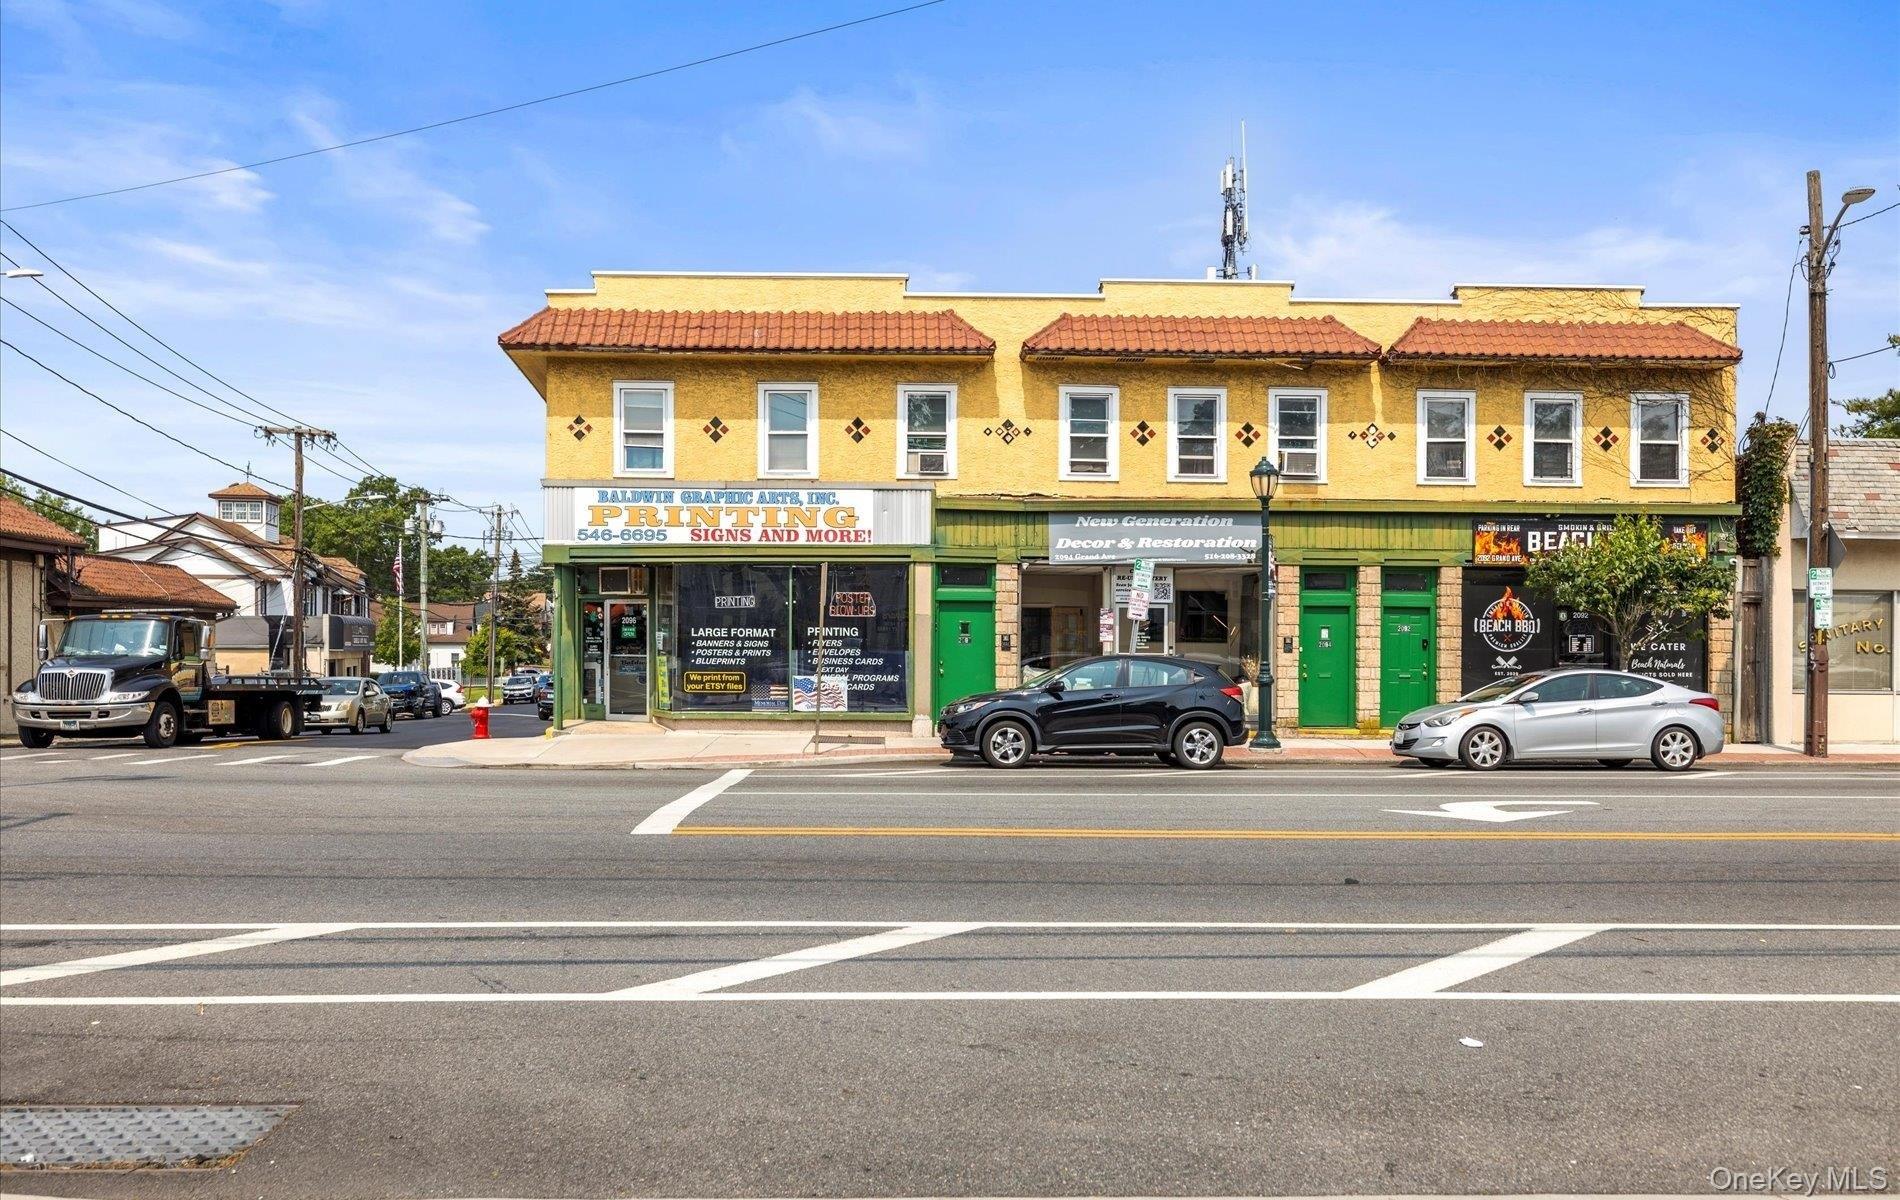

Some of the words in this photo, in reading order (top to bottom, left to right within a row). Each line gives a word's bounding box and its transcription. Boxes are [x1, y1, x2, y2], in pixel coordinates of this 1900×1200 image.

[597, 489, 675, 504] BALDWIN
[680, 490, 754, 505] GRAPHIC
[756, 491, 804, 506] ARTS,
[806, 491, 840, 505] INC.
[587, 505, 860, 528] PRINTING
[1075, 516, 1119, 527] New
[1121, 515, 1234, 527] Generation
[577, 528, 668, 541] 546-6695
[690, 528, 752, 542] SIGNS
[758, 529, 800, 542] AND
[805, 529, 872, 543] MORE!
[1055, 538, 1116, 549] Decor
[1117, 537, 1135, 549] &
[1136, 536, 1258, 548] Restoration
[1477, 554, 1489, 562] 2092
[1491, 554, 1510, 562] GRAND
[1136, 560, 1141, 569] 2
[1810, 569, 1816, 579] 2
[716, 597, 755, 607] PRINTING
[836, 593, 870, 603] POSTER
[830, 605, 875, 615] BLOW-UPS
[1479, 619, 1512, 633] BEACH
[1515, 620, 1536, 633] BBQ
[691, 628, 728, 637] LARGE
[731, 628, 776, 637] FORMAT
[807, 627, 859, 637] PRINTING
[1798, 618, 1885, 653] SNITARY
[743, 640, 769, 648] SIGNS
[1650, 643, 1686, 651] CATER
[742, 649, 772, 657] PRINTS
[1631, 657, 1653, 669] Beach
[1653, 658, 1686, 670] Naturals
[702, 673, 721, 682] print
[721, 673, 740, 681] from
[852, 674, 900, 682] PROGRAMS
[686, 683, 703, 691] your
[705, 682, 726, 690] ETSY
[726, 682, 743, 690] files
[847, 683, 875, 691] CARDS
